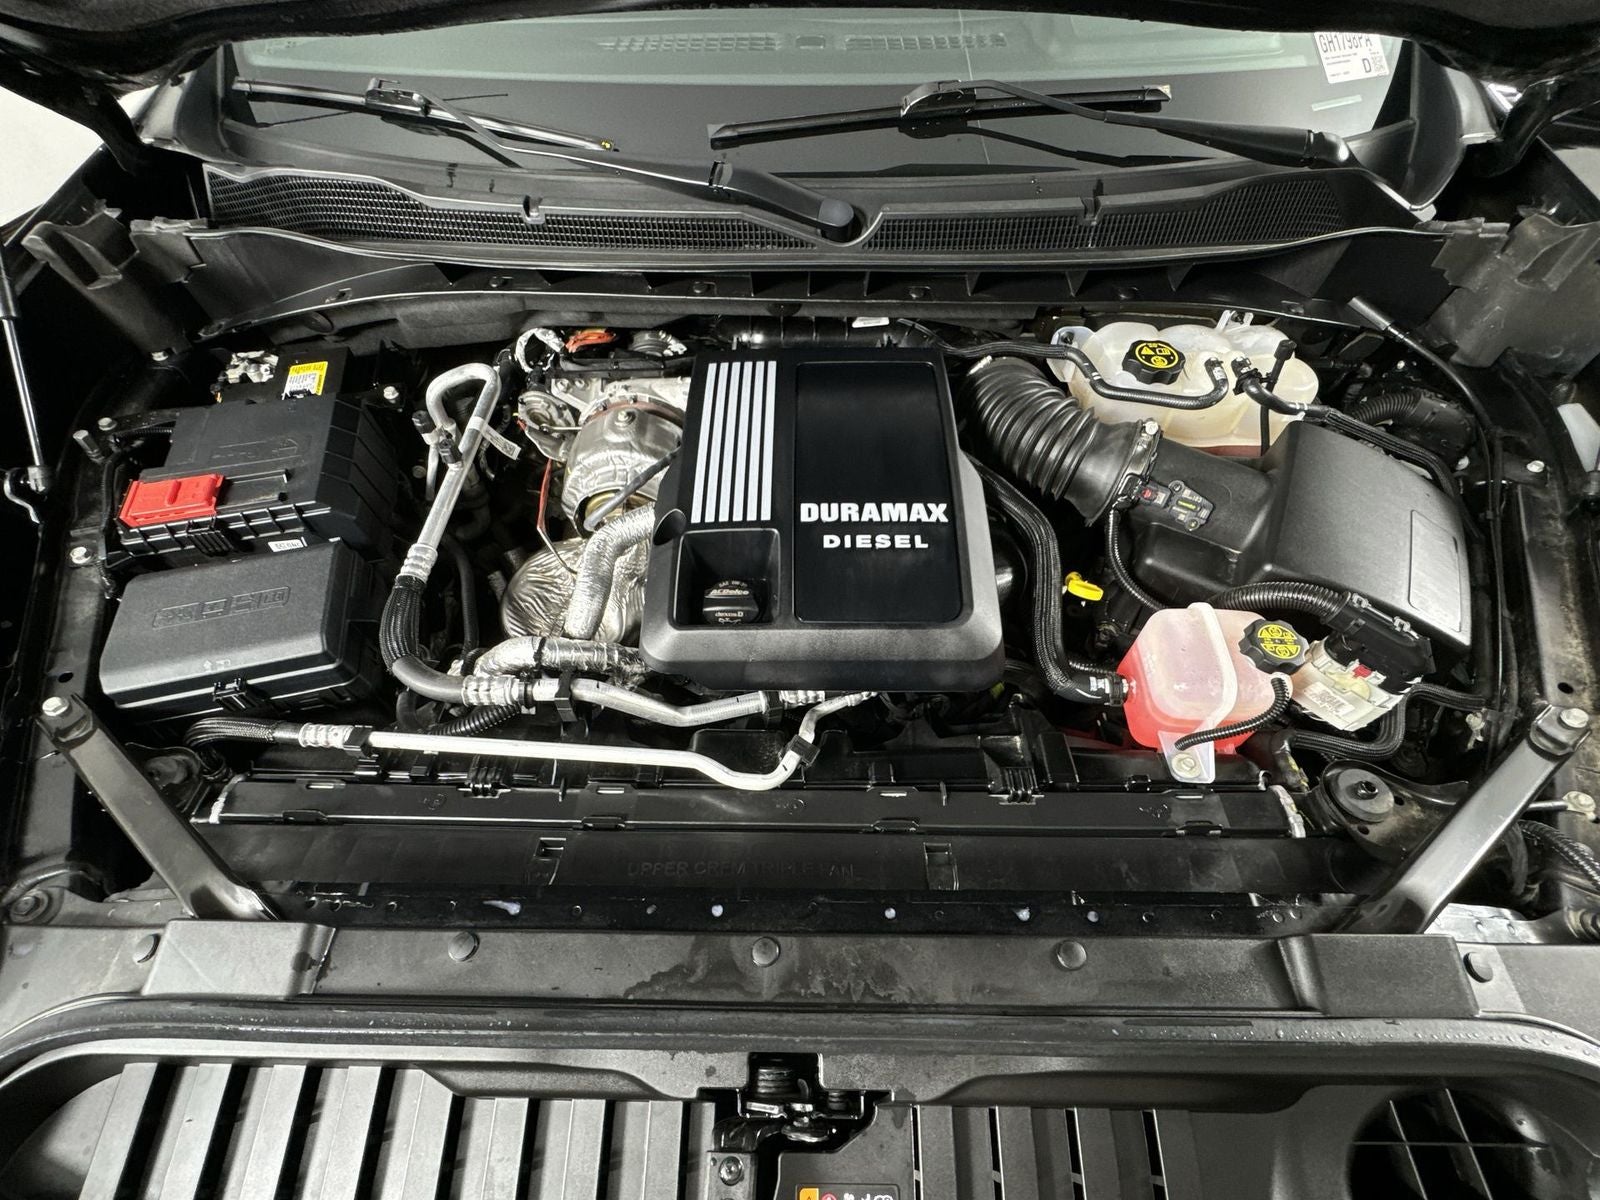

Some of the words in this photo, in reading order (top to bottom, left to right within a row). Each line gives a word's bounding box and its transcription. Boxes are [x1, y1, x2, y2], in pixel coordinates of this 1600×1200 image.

[1362, 57, 1372, 73] D
[800, 502, 949, 523] DURAMAX
[823, 534, 929, 549] DIESEL
[627, 861, 690, 877] UPPER
